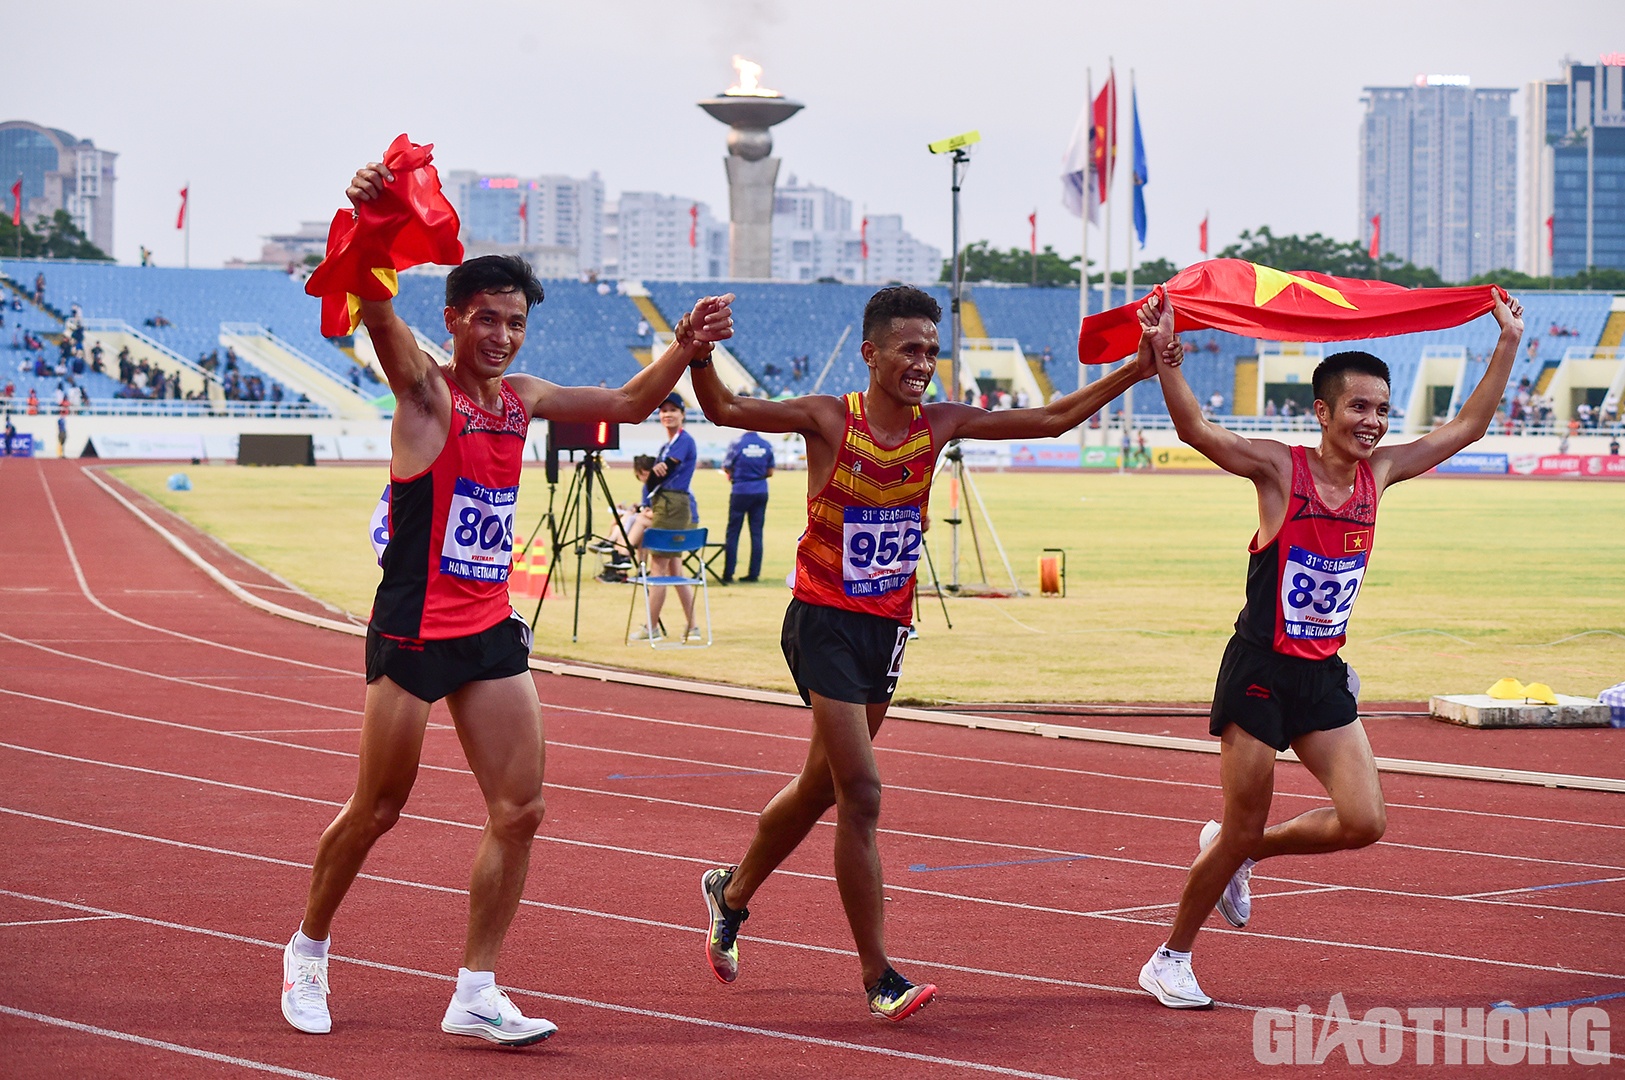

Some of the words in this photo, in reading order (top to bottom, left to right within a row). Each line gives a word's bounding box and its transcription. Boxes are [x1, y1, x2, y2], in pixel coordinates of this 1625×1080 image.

[879, 510, 895, 522] SEA
[895, 509, 920, 521] Games
[850, 527, 921, 568] 952
[1322, 560, 1338, 572] SEA
[1287, 573, 1357, 614] 832
[1305, 615, 1333, 624] VIETNAM
[1285, 623, 1302, 635] ANOI
[1305, 625, 1334, 636] VIETNAM
